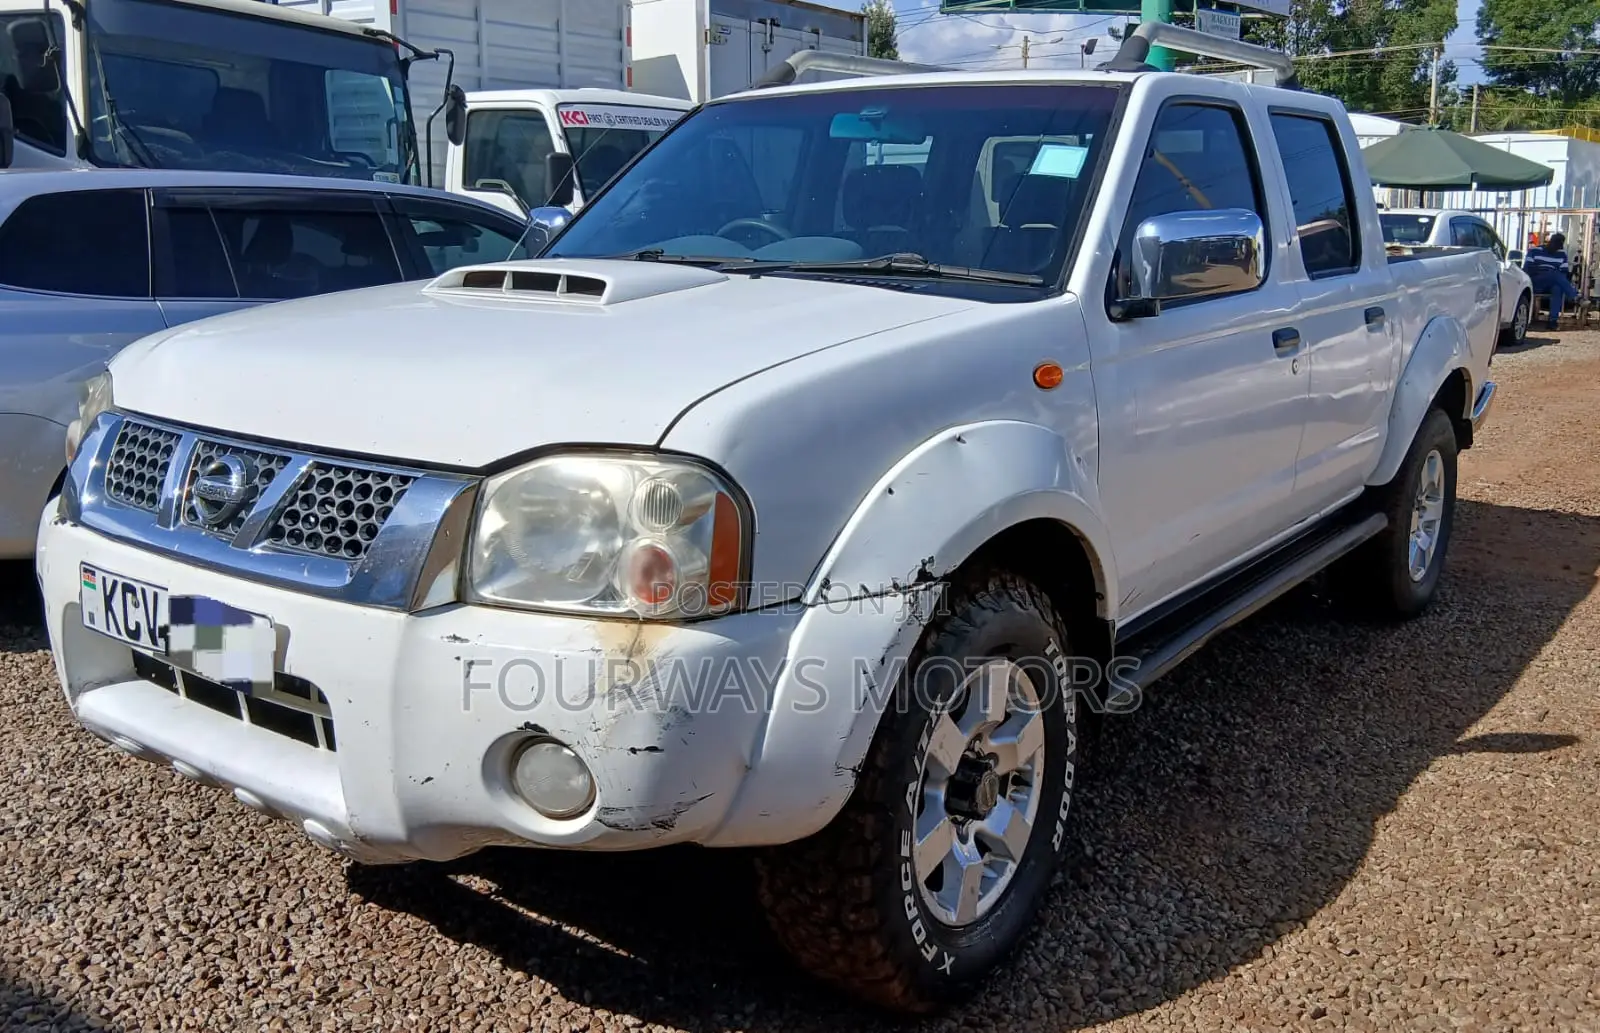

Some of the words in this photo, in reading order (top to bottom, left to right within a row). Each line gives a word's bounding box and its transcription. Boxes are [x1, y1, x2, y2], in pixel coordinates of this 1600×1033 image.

[560, 111, 589, 125] KCI
[588, 113, 603, 124] FIRST
[615, 115, 642, 126] CERTIFIED
[641, 117, 661, 127] DEALER
[102, 576, 160, 647] KCV
[1044, 637, 1077, 852] TOURADOR
[901, 829, 938, 962] FORCE
[937, 951, 956, 975] X
